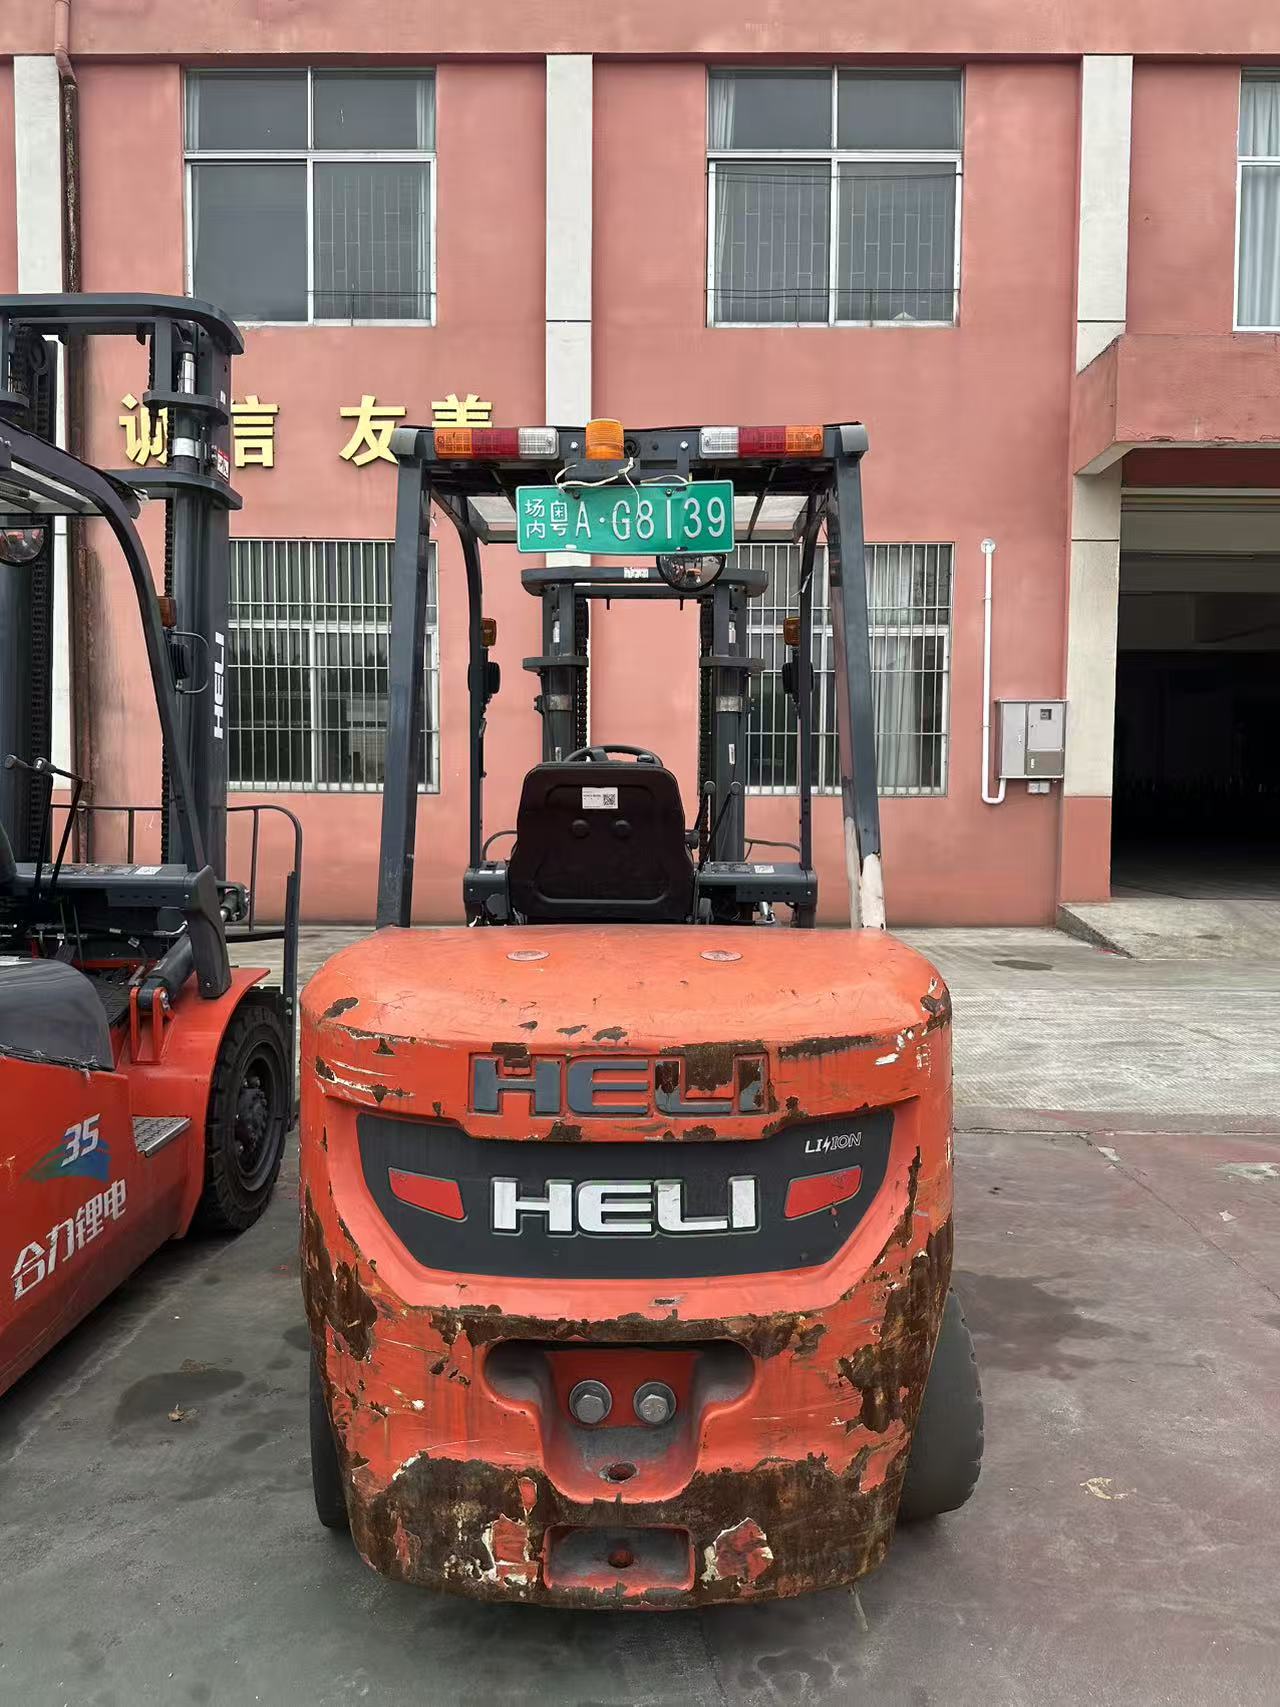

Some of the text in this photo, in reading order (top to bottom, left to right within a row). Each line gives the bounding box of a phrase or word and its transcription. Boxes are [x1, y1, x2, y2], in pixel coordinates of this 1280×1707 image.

[524, 498, 546, 540] 场内
[214, 631, 225, 739] HELI
[473, 1057, 766, 1115] HELI
[61, 1113, 101, 1168] 35
[492, 1177, 757, 1233] HELI
[11, 1178, 127, 1301] 合力锂电
